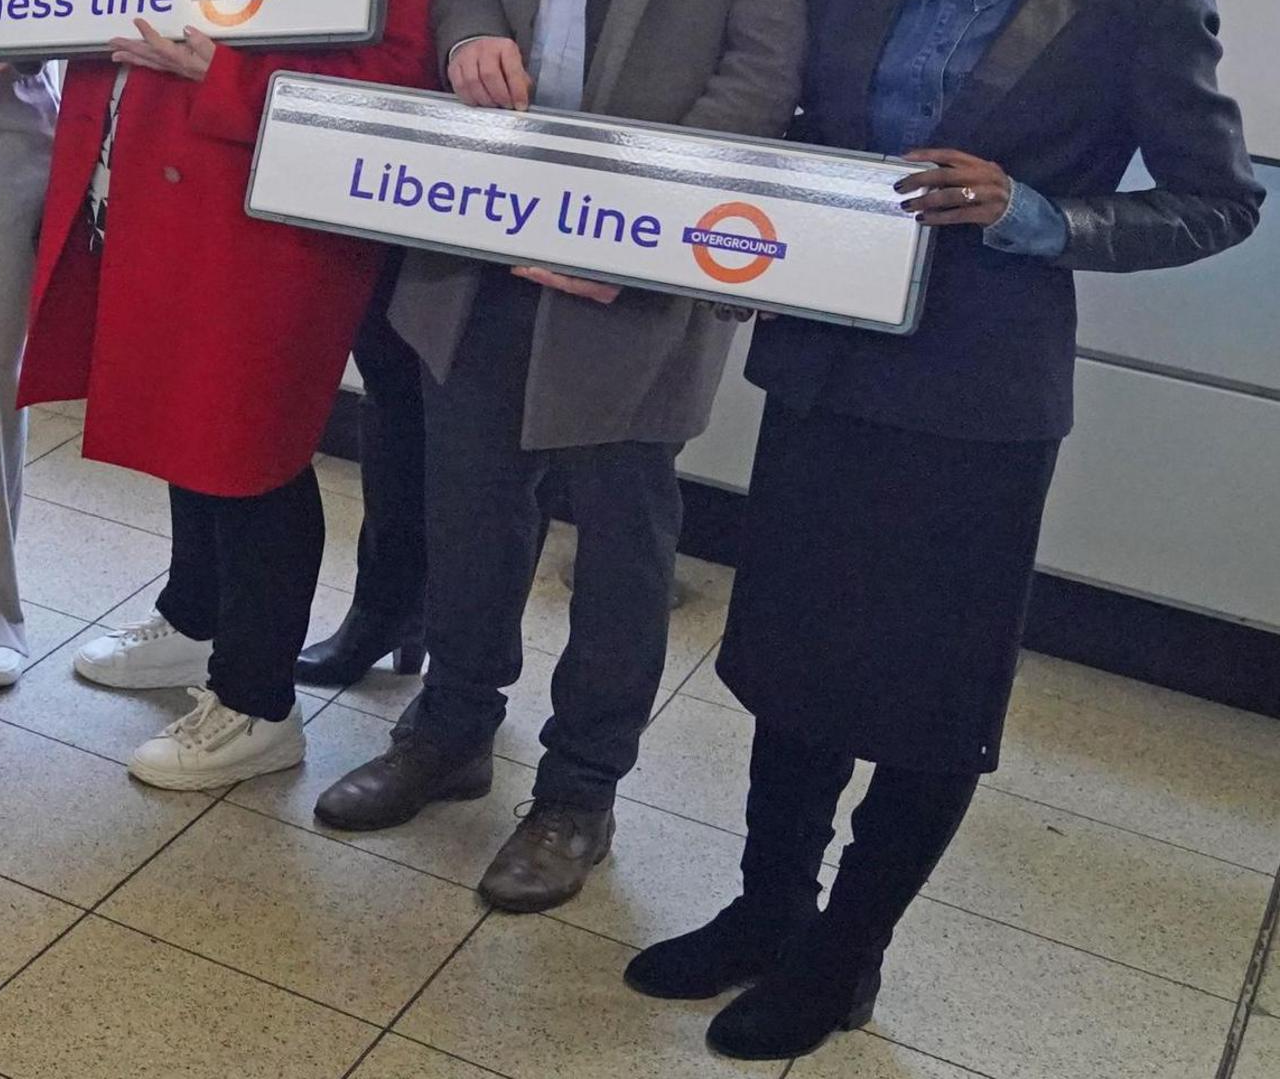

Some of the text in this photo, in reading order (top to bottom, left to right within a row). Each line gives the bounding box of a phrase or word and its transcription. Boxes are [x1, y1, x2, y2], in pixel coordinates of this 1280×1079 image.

[349, 158, 662, 249] Liberty line
[690, 230, 779, 255] OVERGROUND
